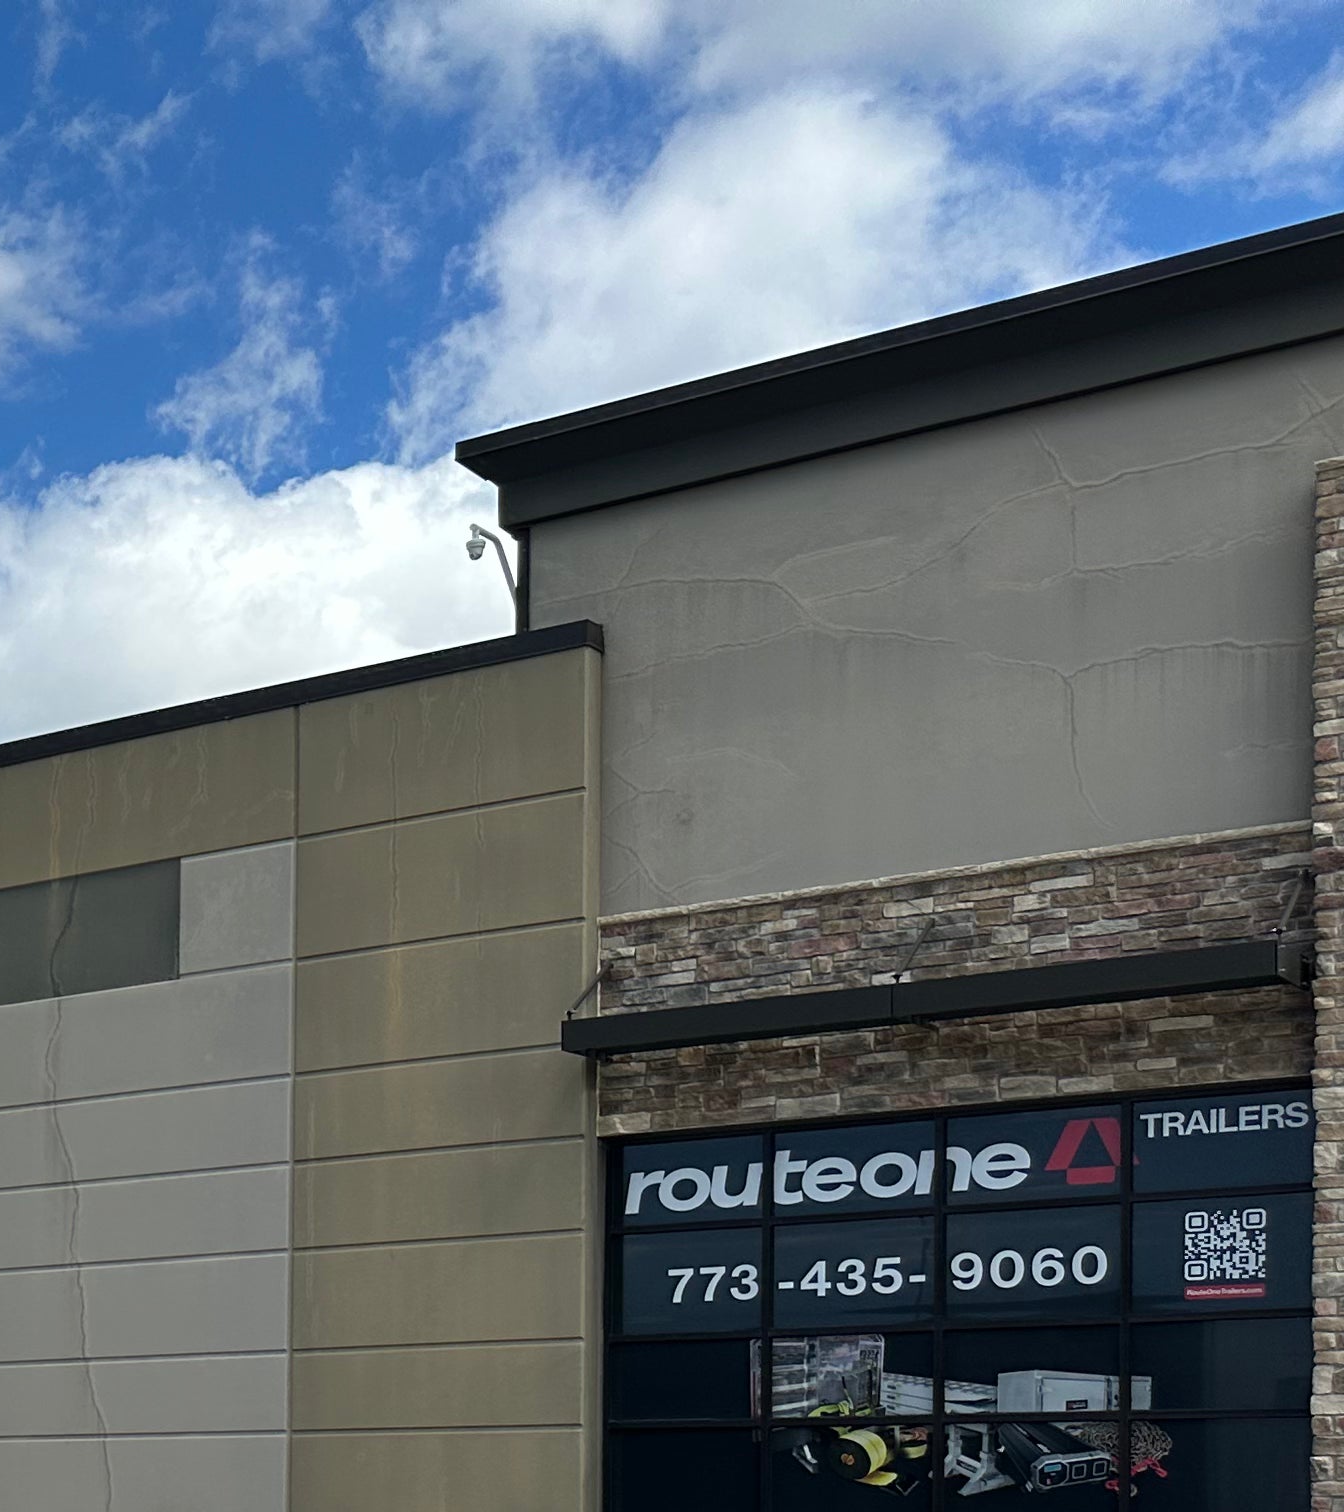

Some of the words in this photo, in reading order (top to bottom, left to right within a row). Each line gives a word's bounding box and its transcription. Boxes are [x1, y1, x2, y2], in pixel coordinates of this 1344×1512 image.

[1140, 1101, 1309, 1138] TRAILERS
[625, 1143, 1031, 1215] routeone
[951, 1246, 1108, 1291] 9060
